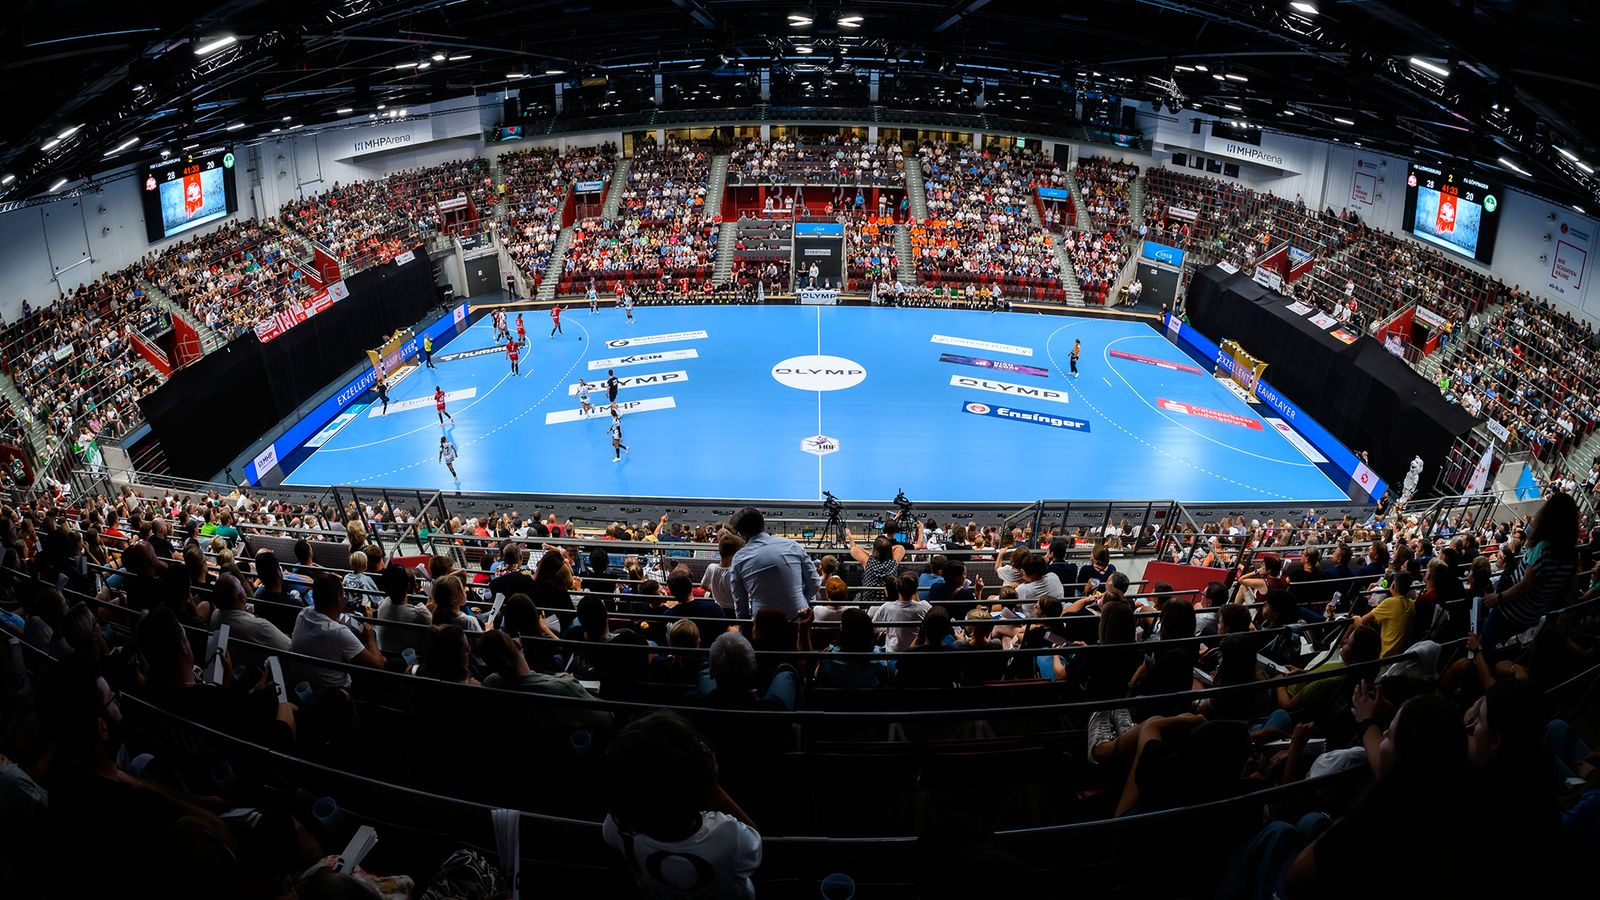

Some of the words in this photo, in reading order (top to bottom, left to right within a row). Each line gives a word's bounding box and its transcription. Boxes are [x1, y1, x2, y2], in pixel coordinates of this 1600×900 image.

[365, 134, 411, 150] MHPArena
[188, 155, 193, 163] 2
[1237, 146, 1283, 165] MHPArena
[183, 165, 200, 175] 41:33
[207, 161, 215, 169] 20
[1426, 180, 1435, 189] 28
[1448, 174, 1453, 183] 2
[1442, 184, 1458, 196] 41:33
[1465, 191, 1474, 201] 20
[1556, 264, 1577, 277] SCHAFFEN
[620, 354, 663, 364] KLEIN
[337, 370, 378, 406] EXZELLENTE
[959, 378, 1061, 398] OLYMP
[997, 407, 1086, 429] Ensinger
[1191, 405, 1254, 424] Kreissparkasse
[1193, 410, 1248, 428] Ludwigsburg
[262, 451, 273, 464] MHP
